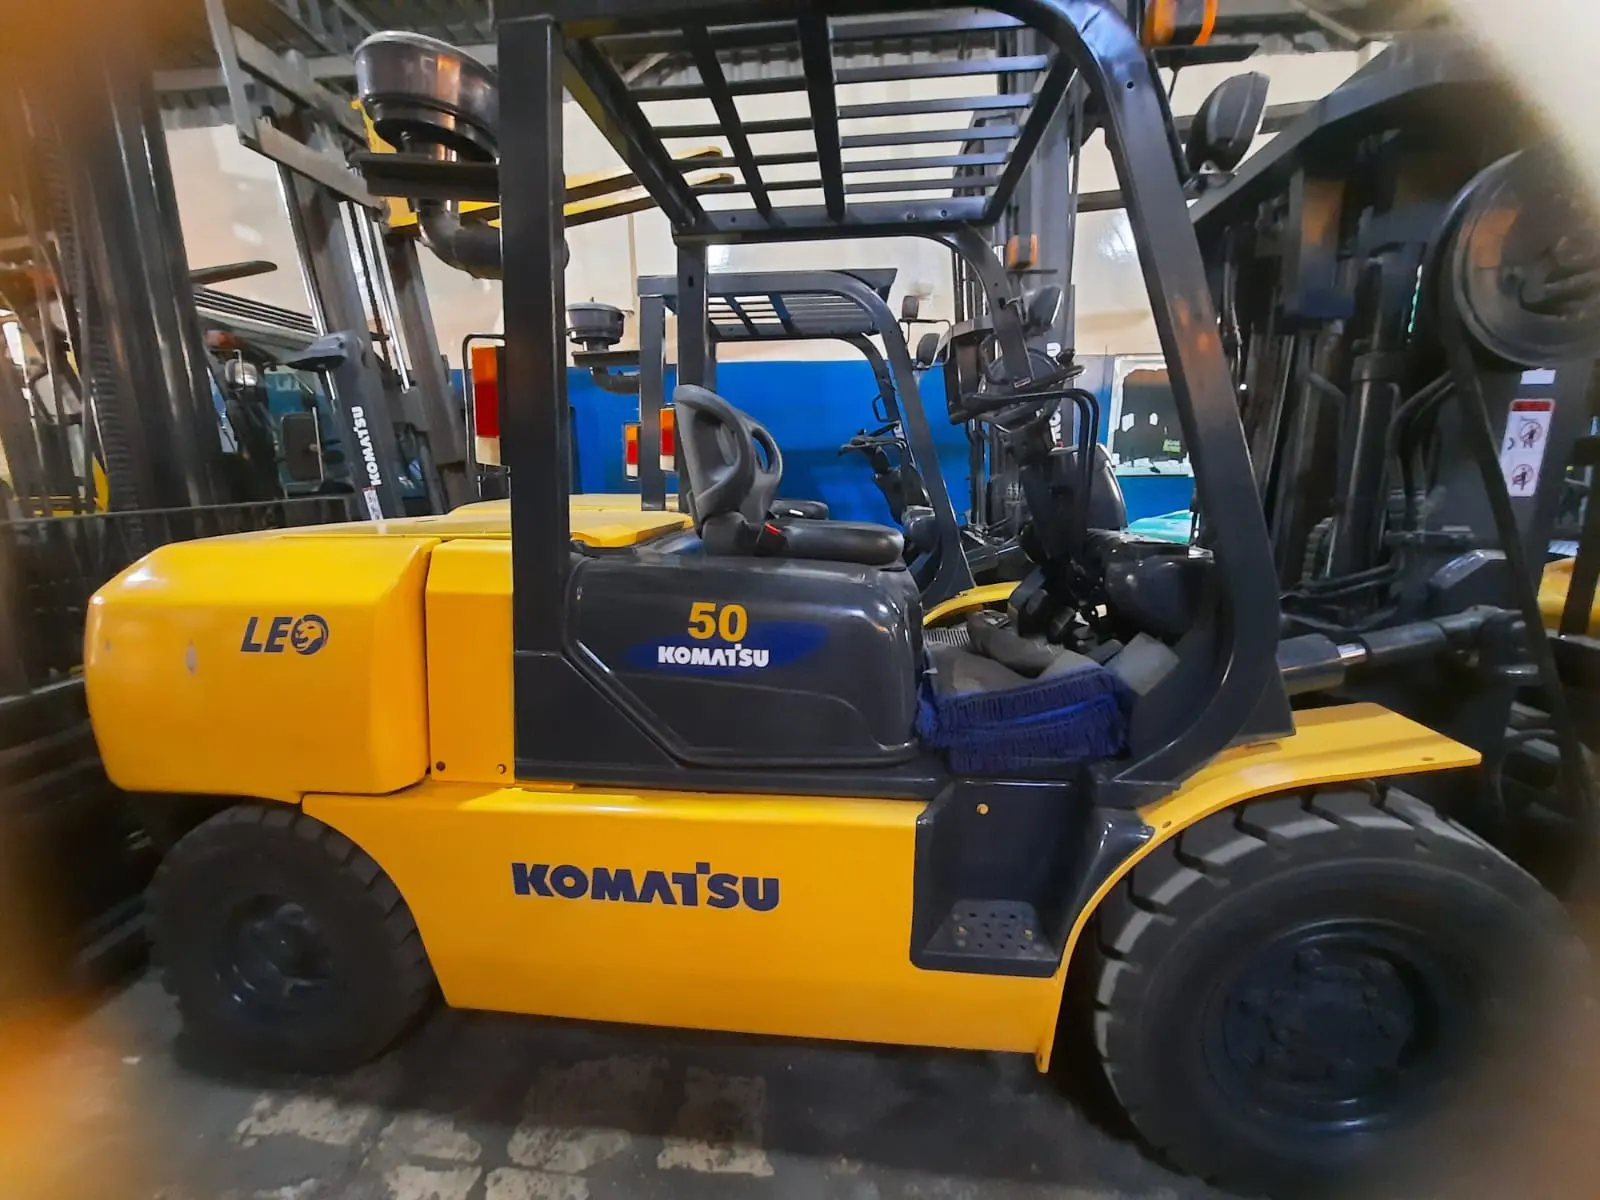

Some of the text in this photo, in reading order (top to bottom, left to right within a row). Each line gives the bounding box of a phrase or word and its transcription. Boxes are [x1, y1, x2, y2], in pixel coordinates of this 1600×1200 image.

[351, 406, 382, 486] KOMATSU
[687, 601, 748, 642] 50
[657, 643, 769, 668] KOMATSU
[511, 862, 780, 912] KOMATSU
